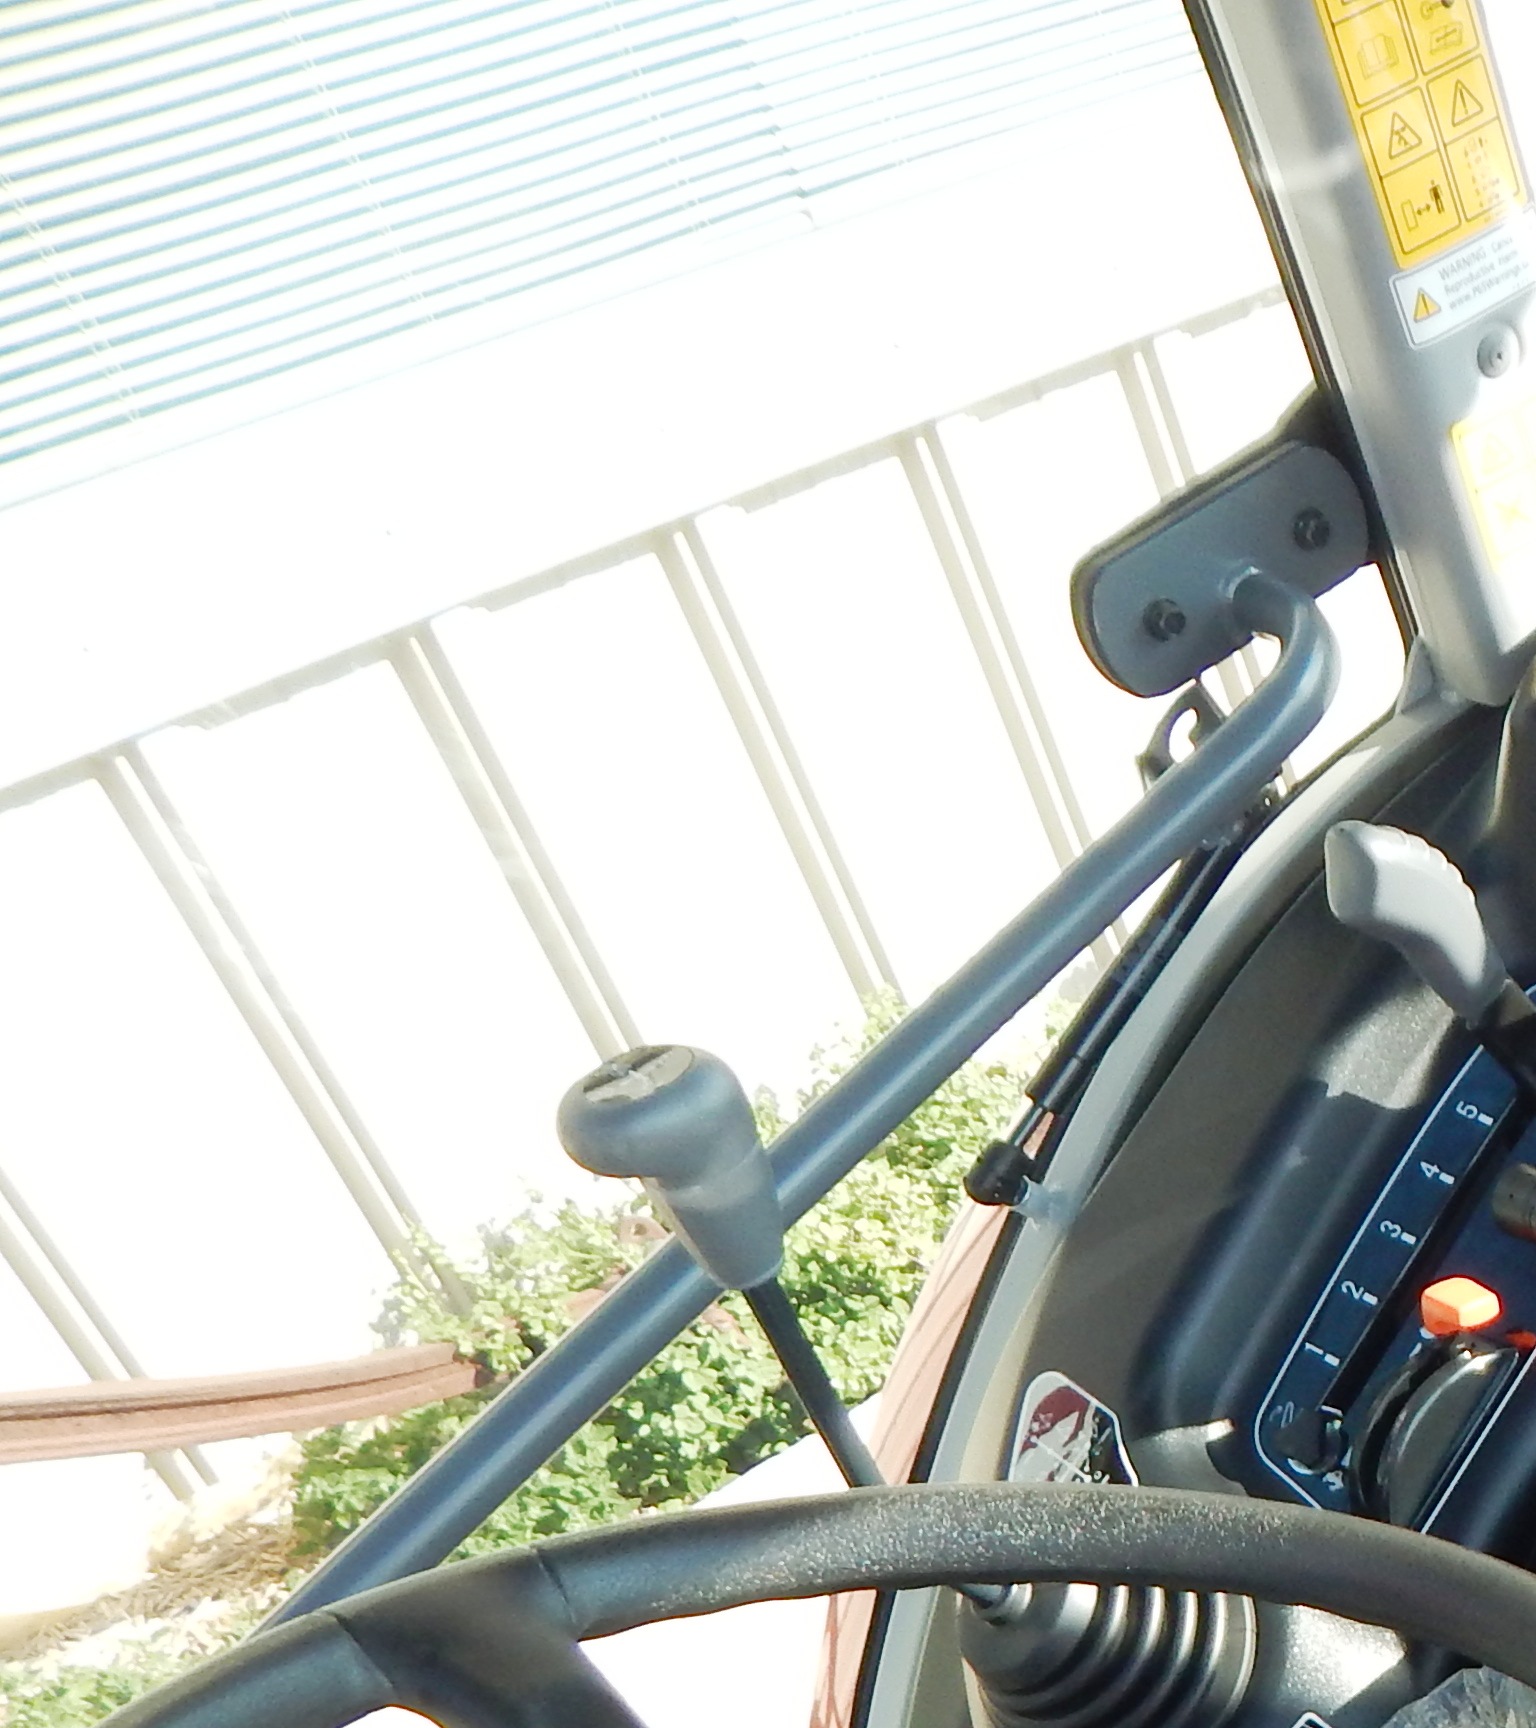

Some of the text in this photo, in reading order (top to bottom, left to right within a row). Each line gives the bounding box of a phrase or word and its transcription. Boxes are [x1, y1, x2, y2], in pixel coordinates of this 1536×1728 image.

[1456, 1101, 1478, 1119] 5
[1420, 1160, 1439, 1178] 4
[1380, 1220, 1402, 1238] 3
[1341, 1280, 1364, 1299] 2
[1305, 1341, 1324, 1355] 1
